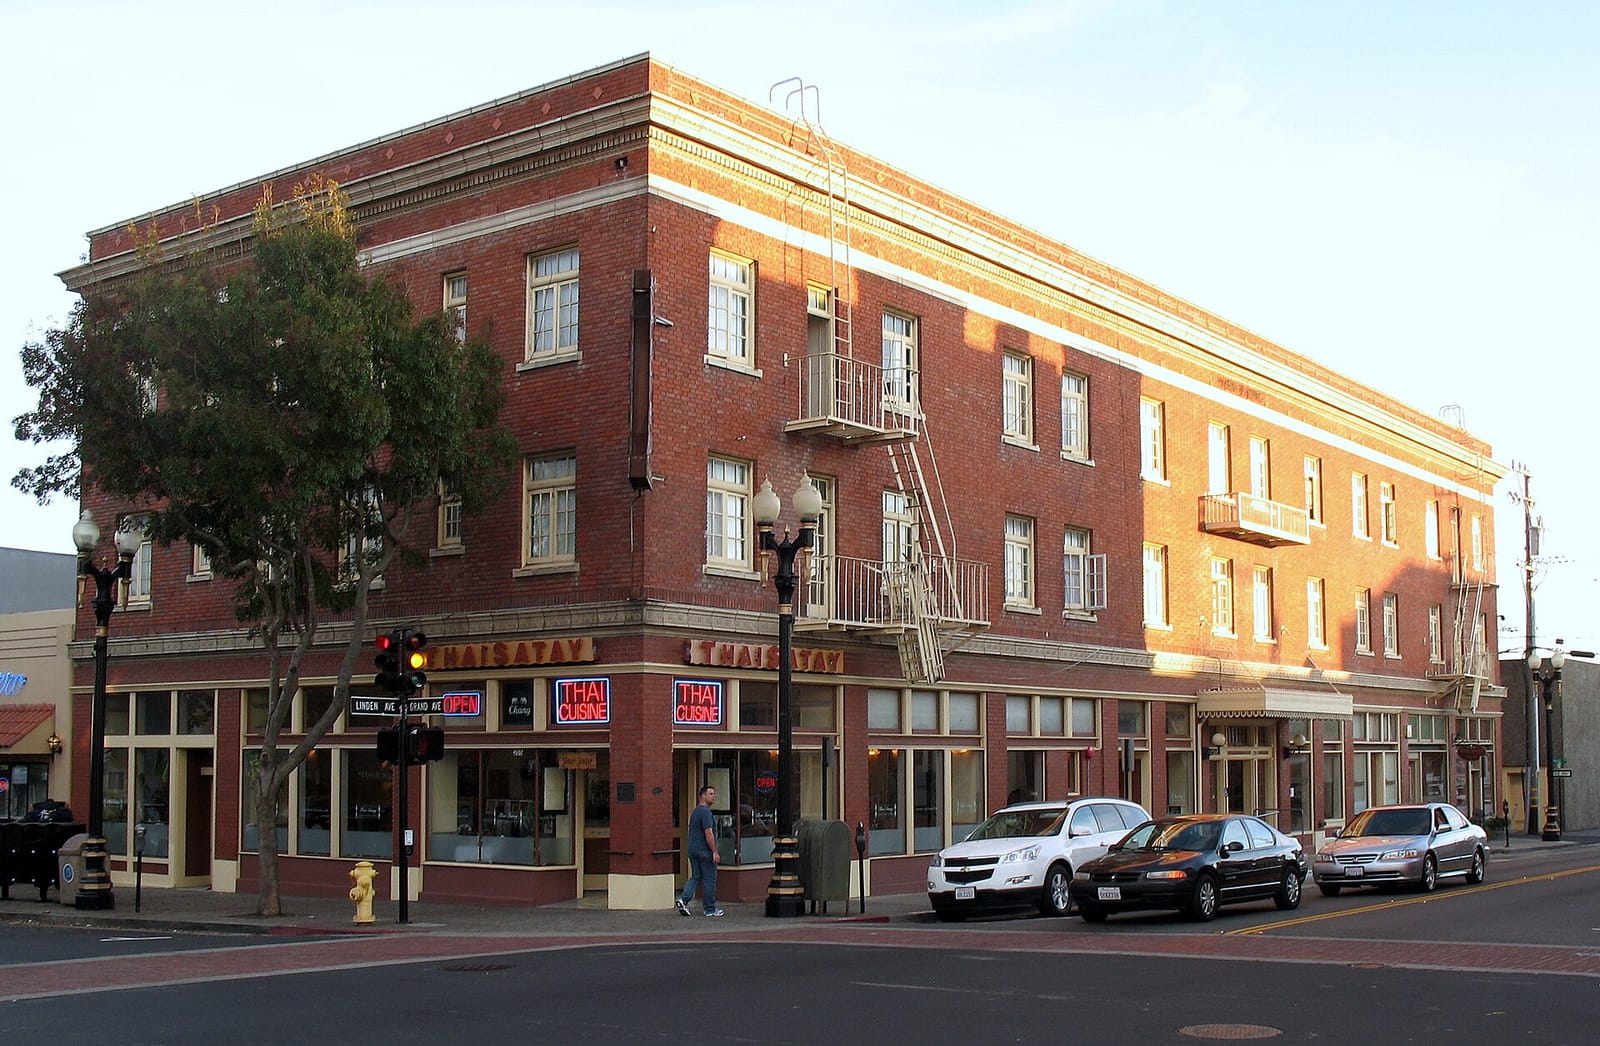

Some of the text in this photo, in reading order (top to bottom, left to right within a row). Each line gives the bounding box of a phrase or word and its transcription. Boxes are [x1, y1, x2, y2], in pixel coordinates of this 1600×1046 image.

[560, 681, 604, 703] THAI
[678, 683, 716, 705] THAI
[355, 700, 379, 711] LINDEN
[384, 702, 396, 712] AVE
[409, 701, 428, 712] GRAND
[431, 701, 442, 711] AVE
[443, 696, 478, 713] OPEN
[559, 702, 607, 721] CUISINE
[676, 704, 719, 722] CUISINE
[756, 777, 776, 788] OPEN
